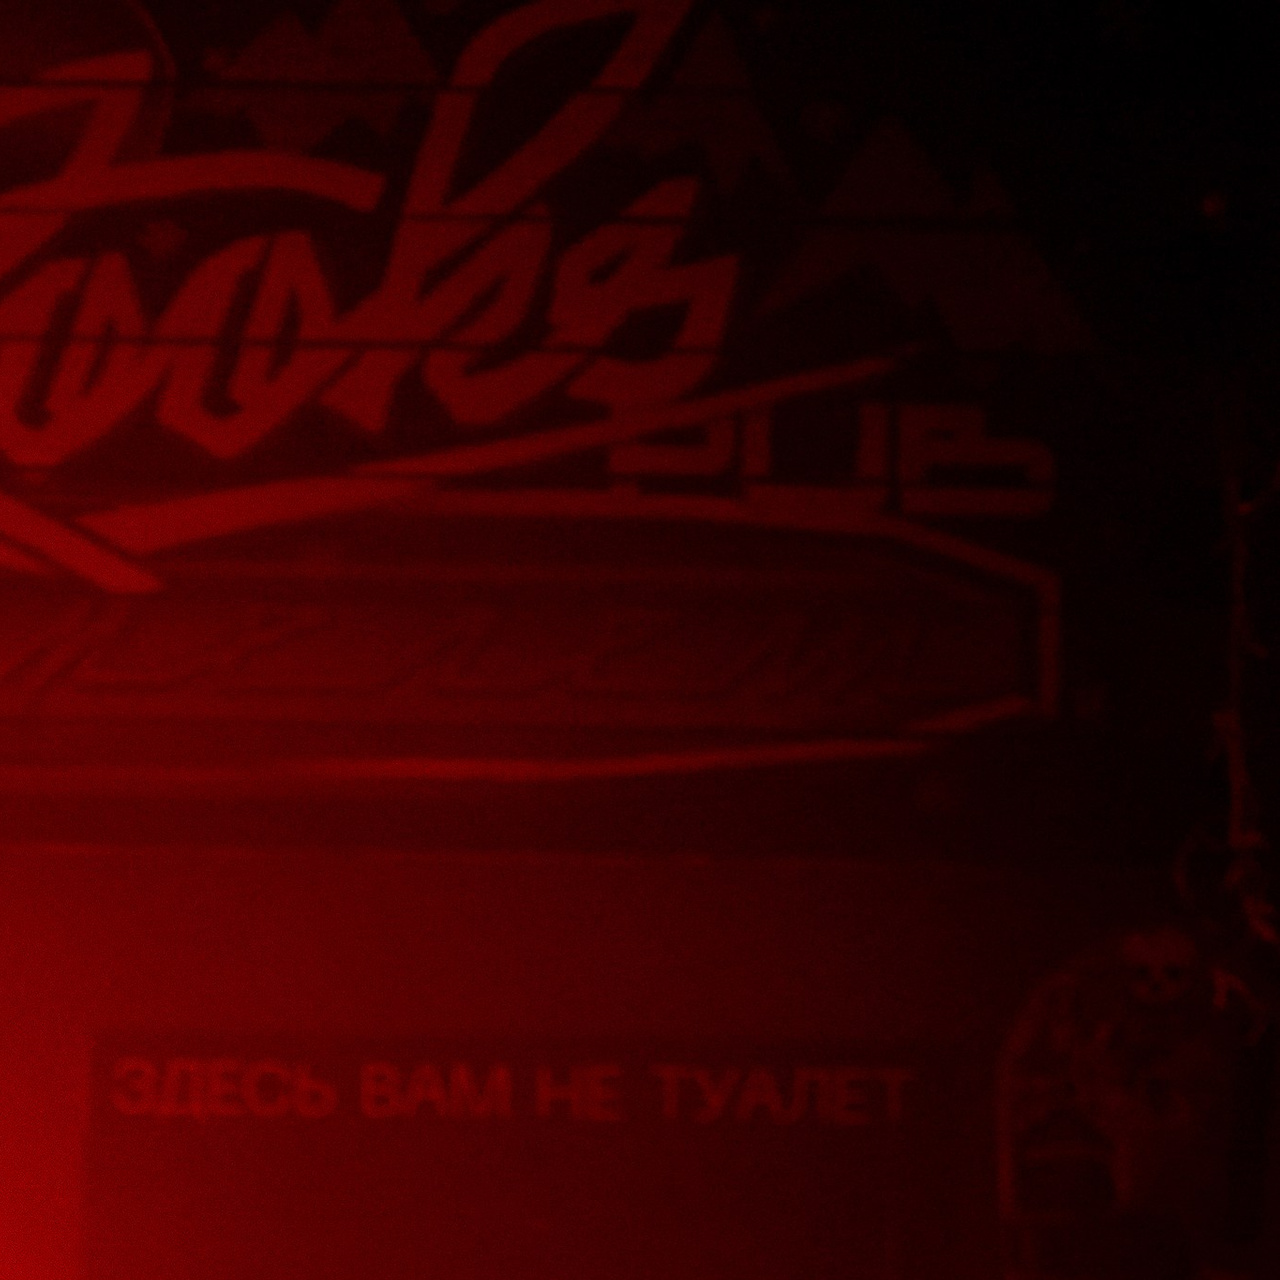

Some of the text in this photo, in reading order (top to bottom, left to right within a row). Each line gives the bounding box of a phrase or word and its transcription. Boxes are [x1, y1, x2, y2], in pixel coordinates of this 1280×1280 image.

[607, 402, 1057, 518] PUB
[111, 1055, 917, 1127] ЗДЕСЬ ВАМ НЕ ТУАЛЕТ
